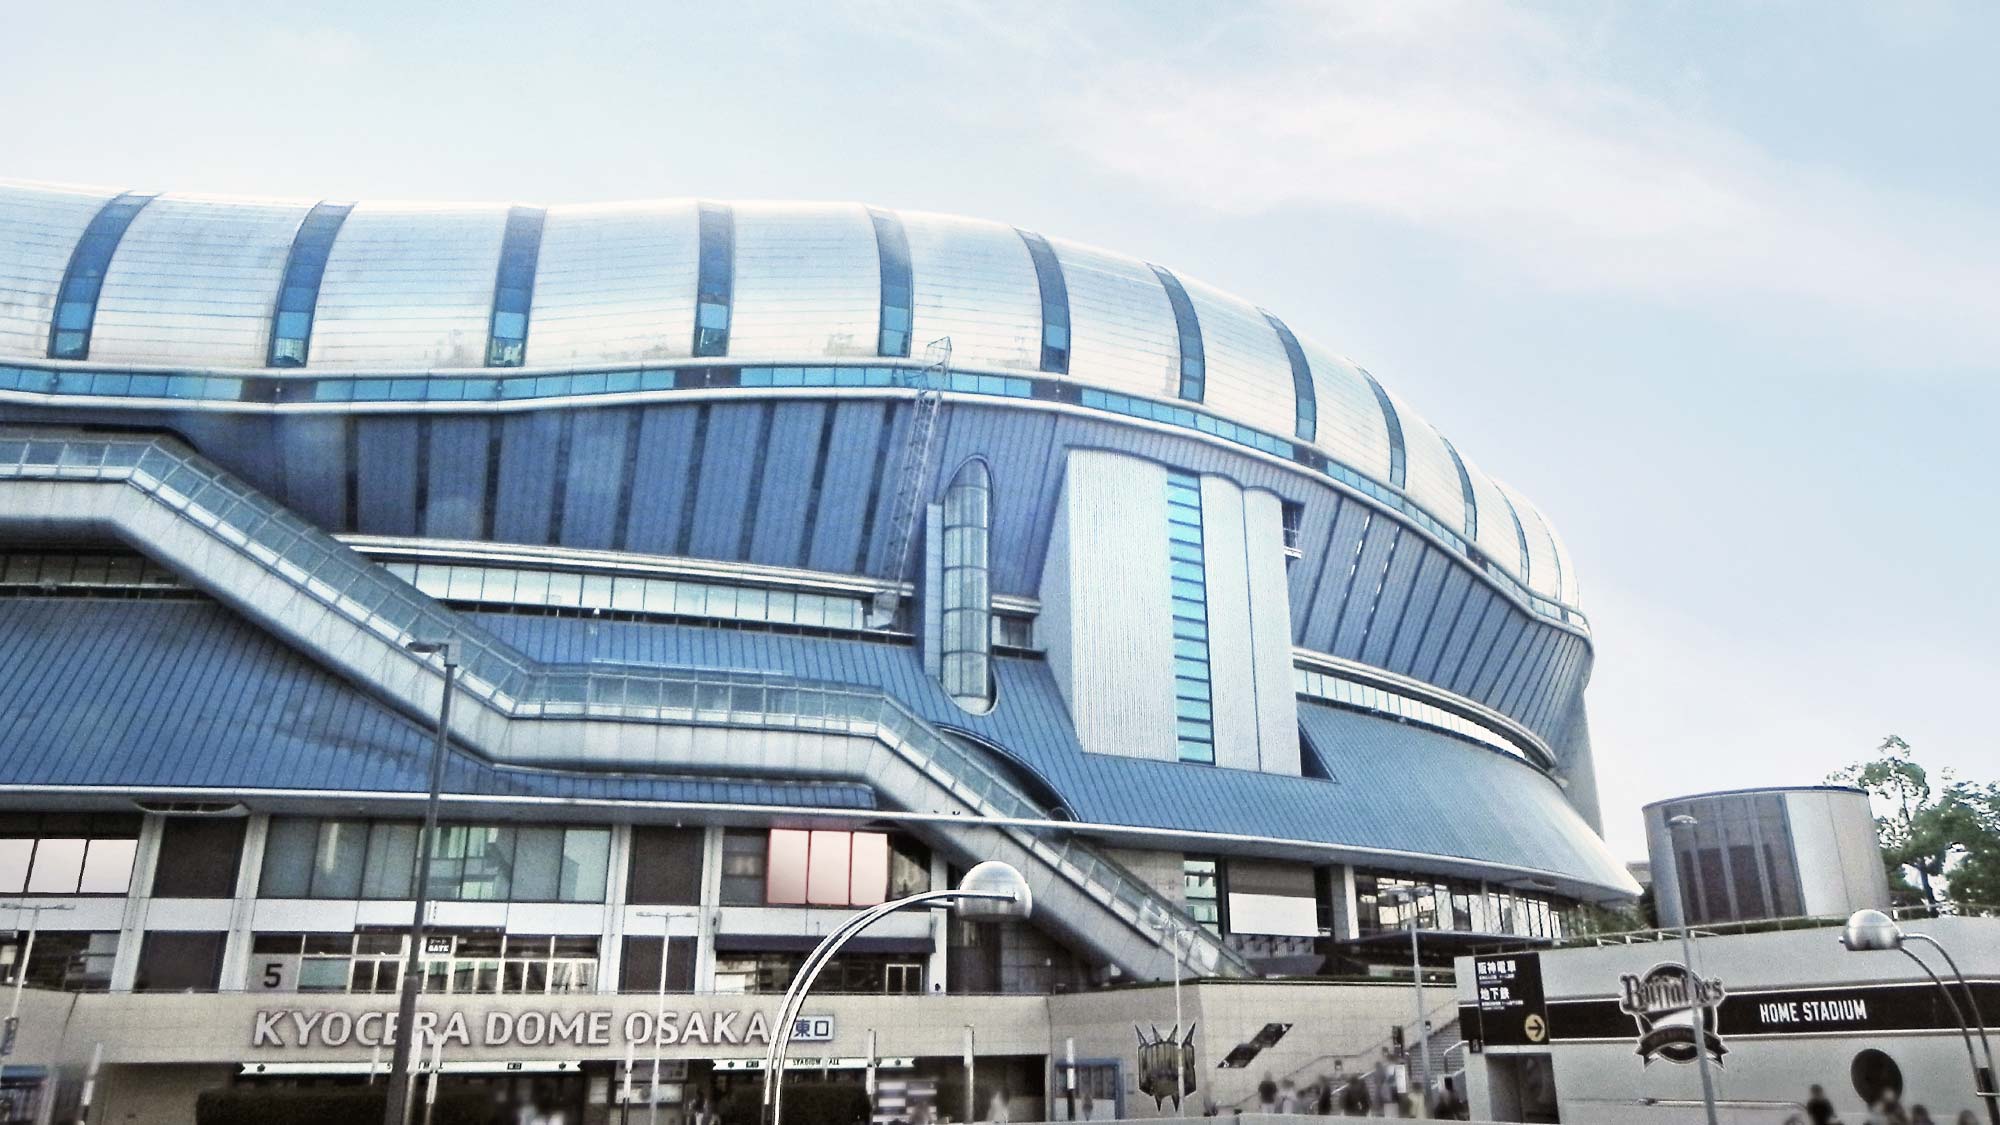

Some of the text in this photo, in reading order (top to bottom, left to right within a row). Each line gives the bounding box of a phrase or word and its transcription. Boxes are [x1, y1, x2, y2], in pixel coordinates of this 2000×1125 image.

[427, 944, 449, 952] GATE
[263, 963, 283, 988] 5
[1480, 987, 1510, 1000] 地下鉄
[1759, 999, 1867, 1023] HOME STADIUM
[253, 1010, 771, 1047] KYOCERA DOME OSAKA
[794, 1019, 829, 1037] 東口
